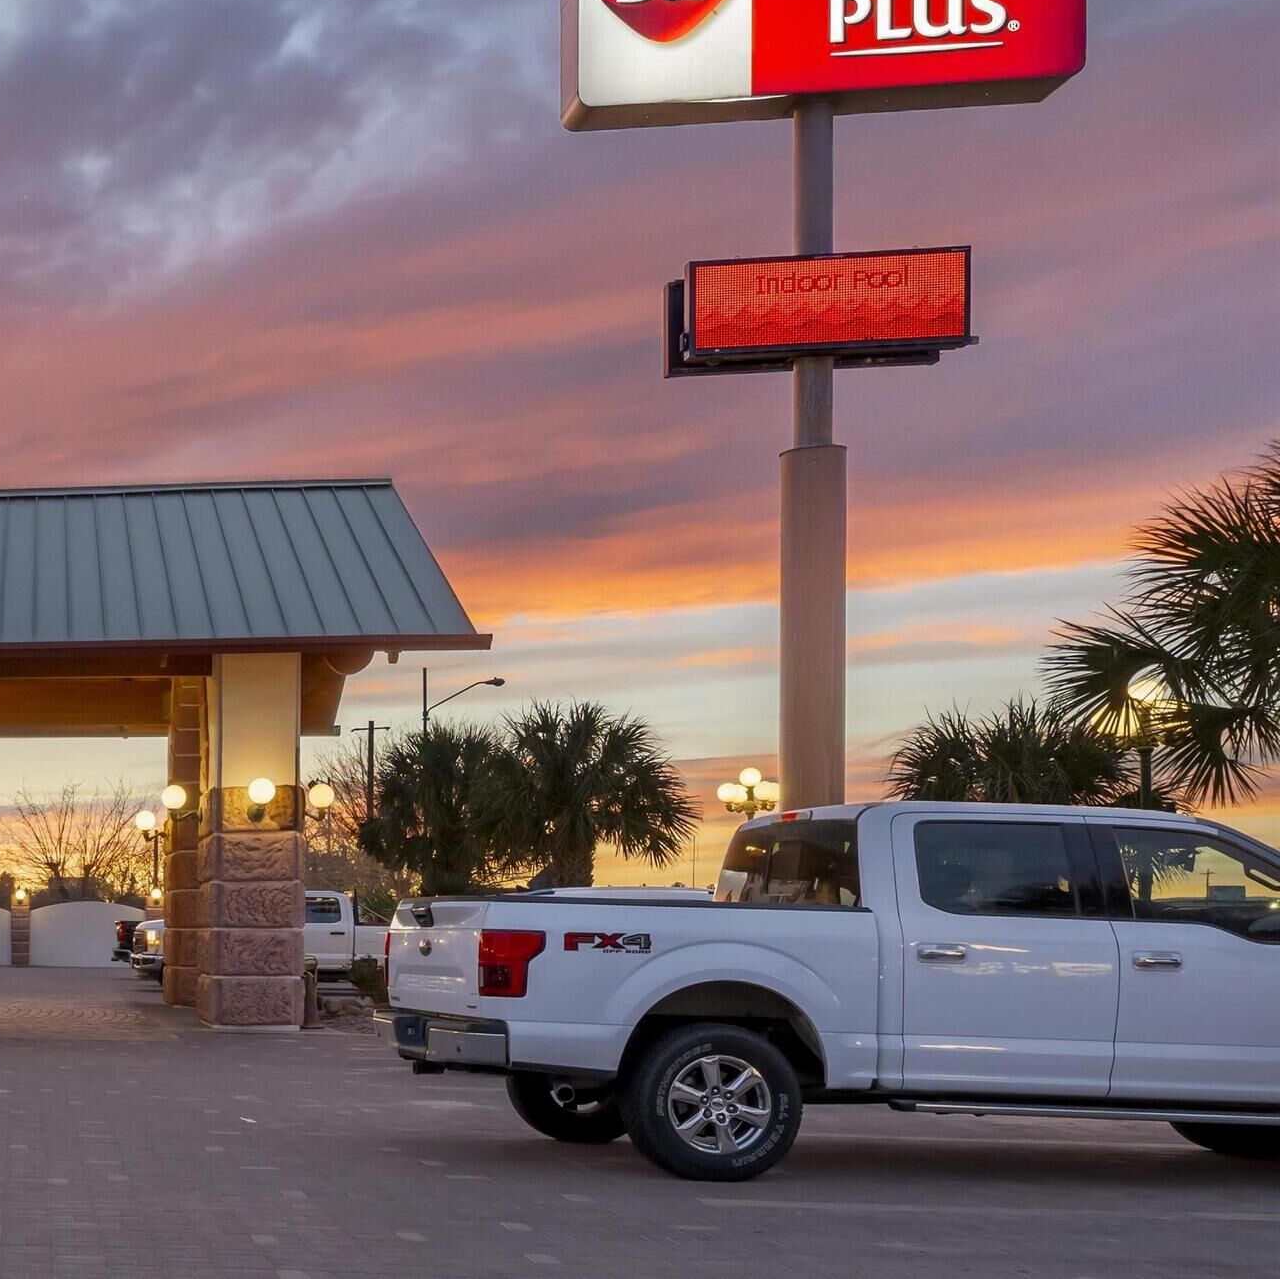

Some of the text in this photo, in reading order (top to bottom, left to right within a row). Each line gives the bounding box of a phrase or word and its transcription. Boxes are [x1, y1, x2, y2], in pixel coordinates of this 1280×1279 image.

[755, 265, 909, 295] Indoor Pool
[563, 932, 652, 951] FX4
